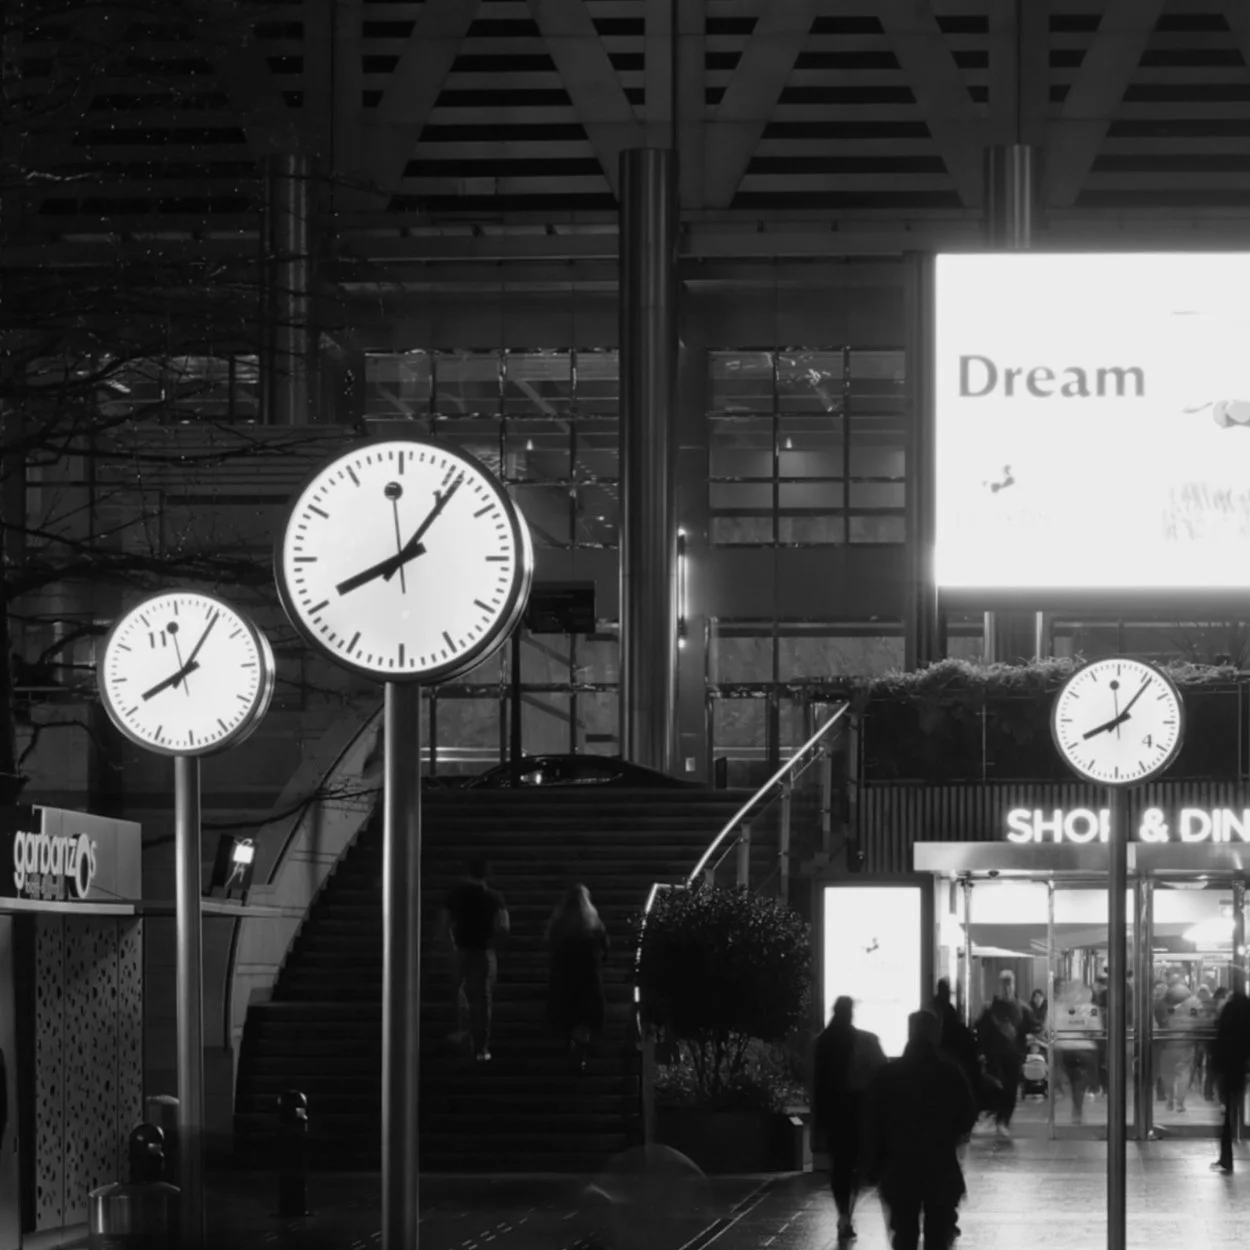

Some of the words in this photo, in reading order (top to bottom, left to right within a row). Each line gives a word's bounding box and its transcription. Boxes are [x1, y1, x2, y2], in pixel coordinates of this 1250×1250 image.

[958, 354, 1146, 399] Dream
[148, 629, 168, 650] 11
[1141, 733, 1153, 749] 4
[1138, 806, 1170, 843] &
